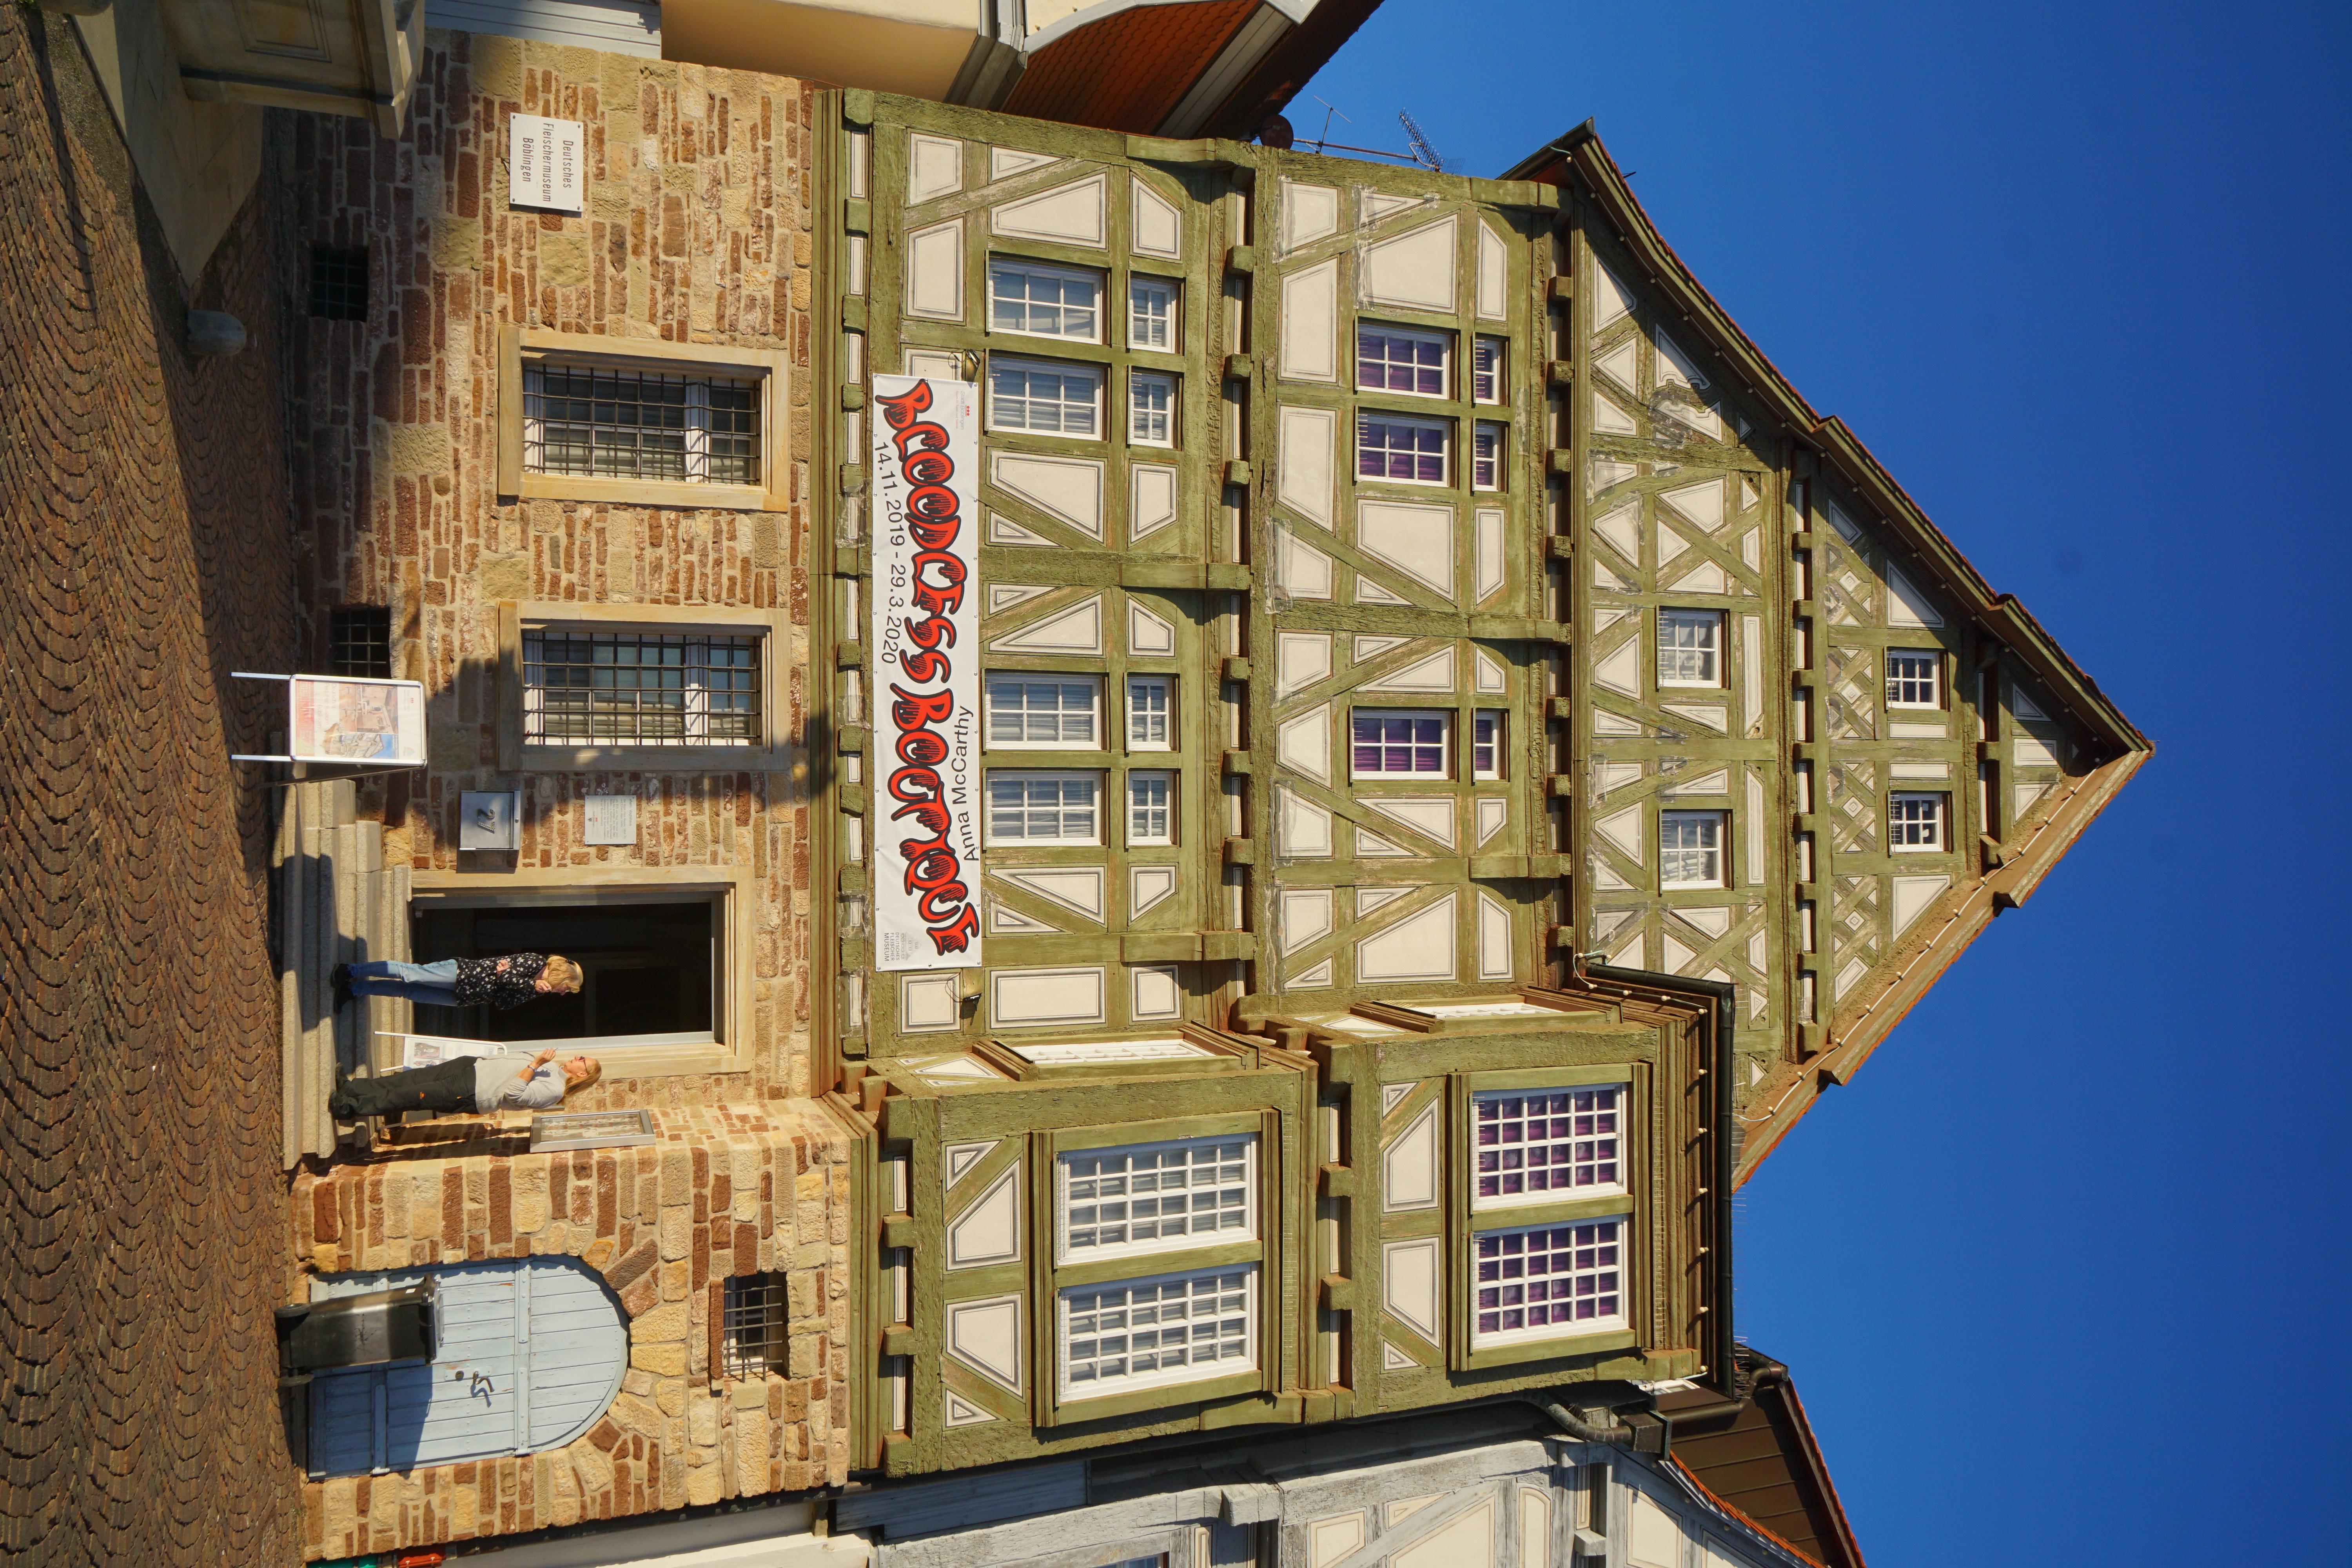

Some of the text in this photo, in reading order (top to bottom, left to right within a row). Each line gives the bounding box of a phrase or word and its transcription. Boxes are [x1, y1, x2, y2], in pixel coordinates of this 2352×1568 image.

[521, 138, 534, 182] Böblingen
[543, 123, 554, 201] Fleischermuseum
[563, 140, 574, 188] Deutsches
[951, 706, 979, 861] Anna McCarthy
[477, 808, 495, 833] 27
[887, 682, 980, 956] BOUTIQUE
